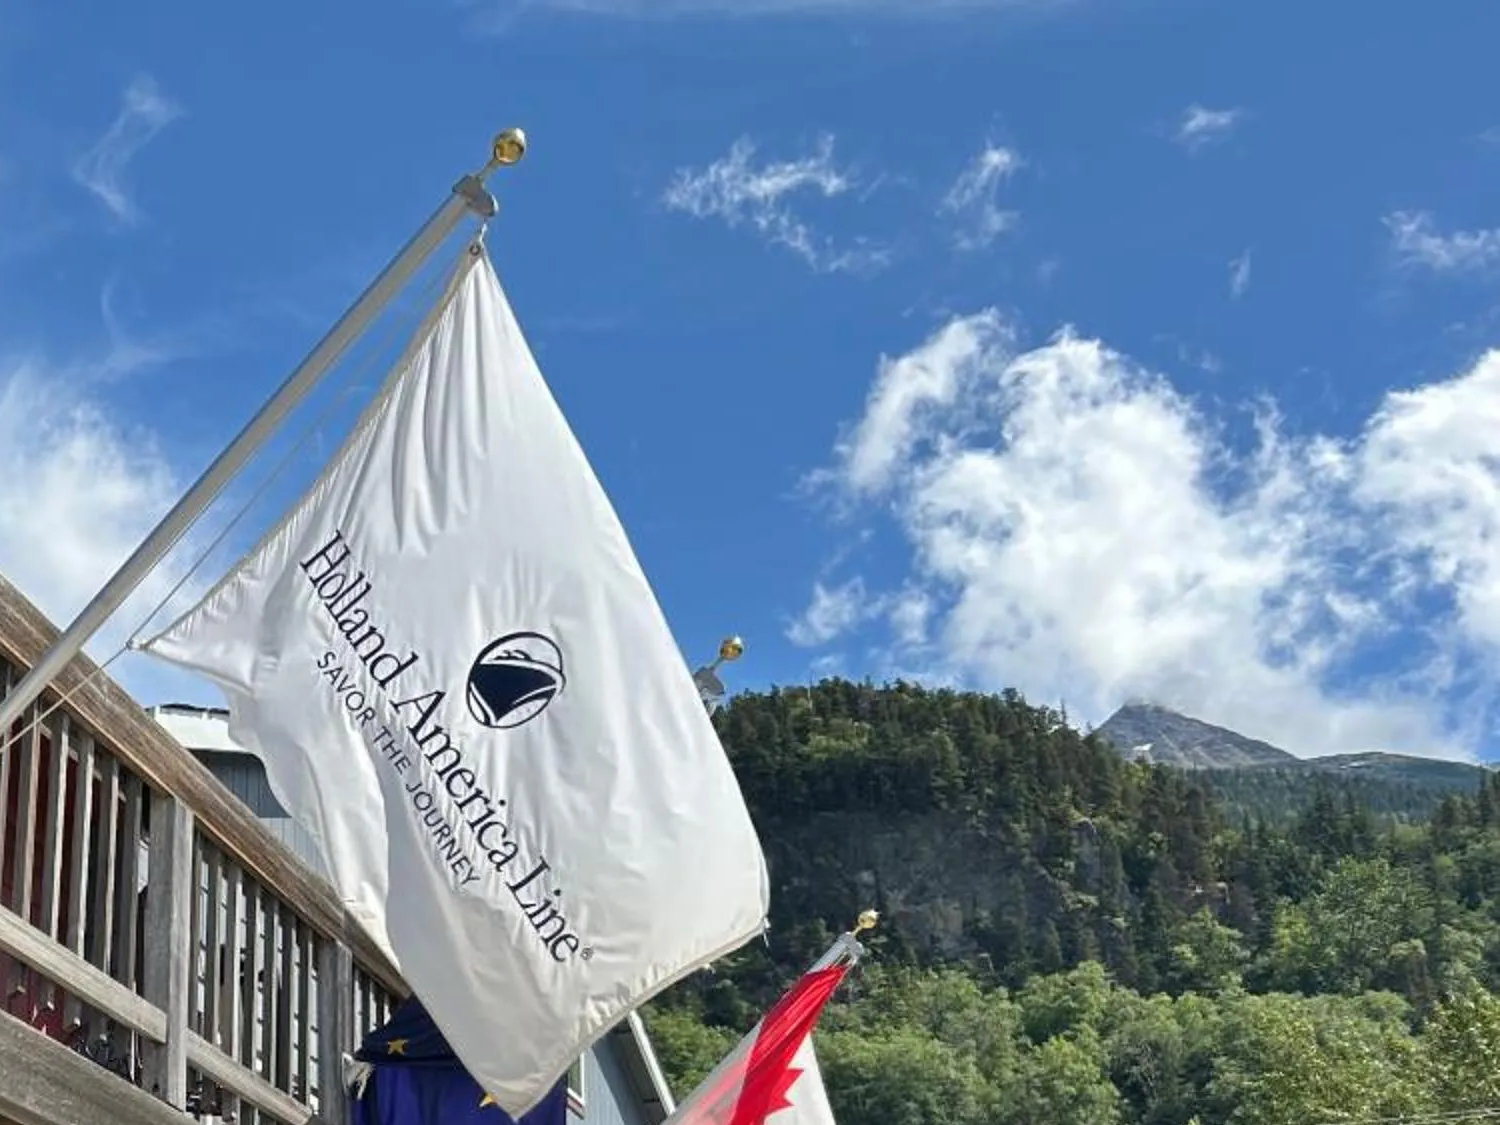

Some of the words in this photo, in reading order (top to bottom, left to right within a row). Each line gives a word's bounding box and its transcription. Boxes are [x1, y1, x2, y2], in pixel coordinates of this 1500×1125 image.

[300, 529, 419, 690] Holland
[389, 689, 519, 872] America
[316, 651, 375, 728] SAVOR
[373, 725, 412, 775] THE
[405, 782, 481, 886] JOURNEY
